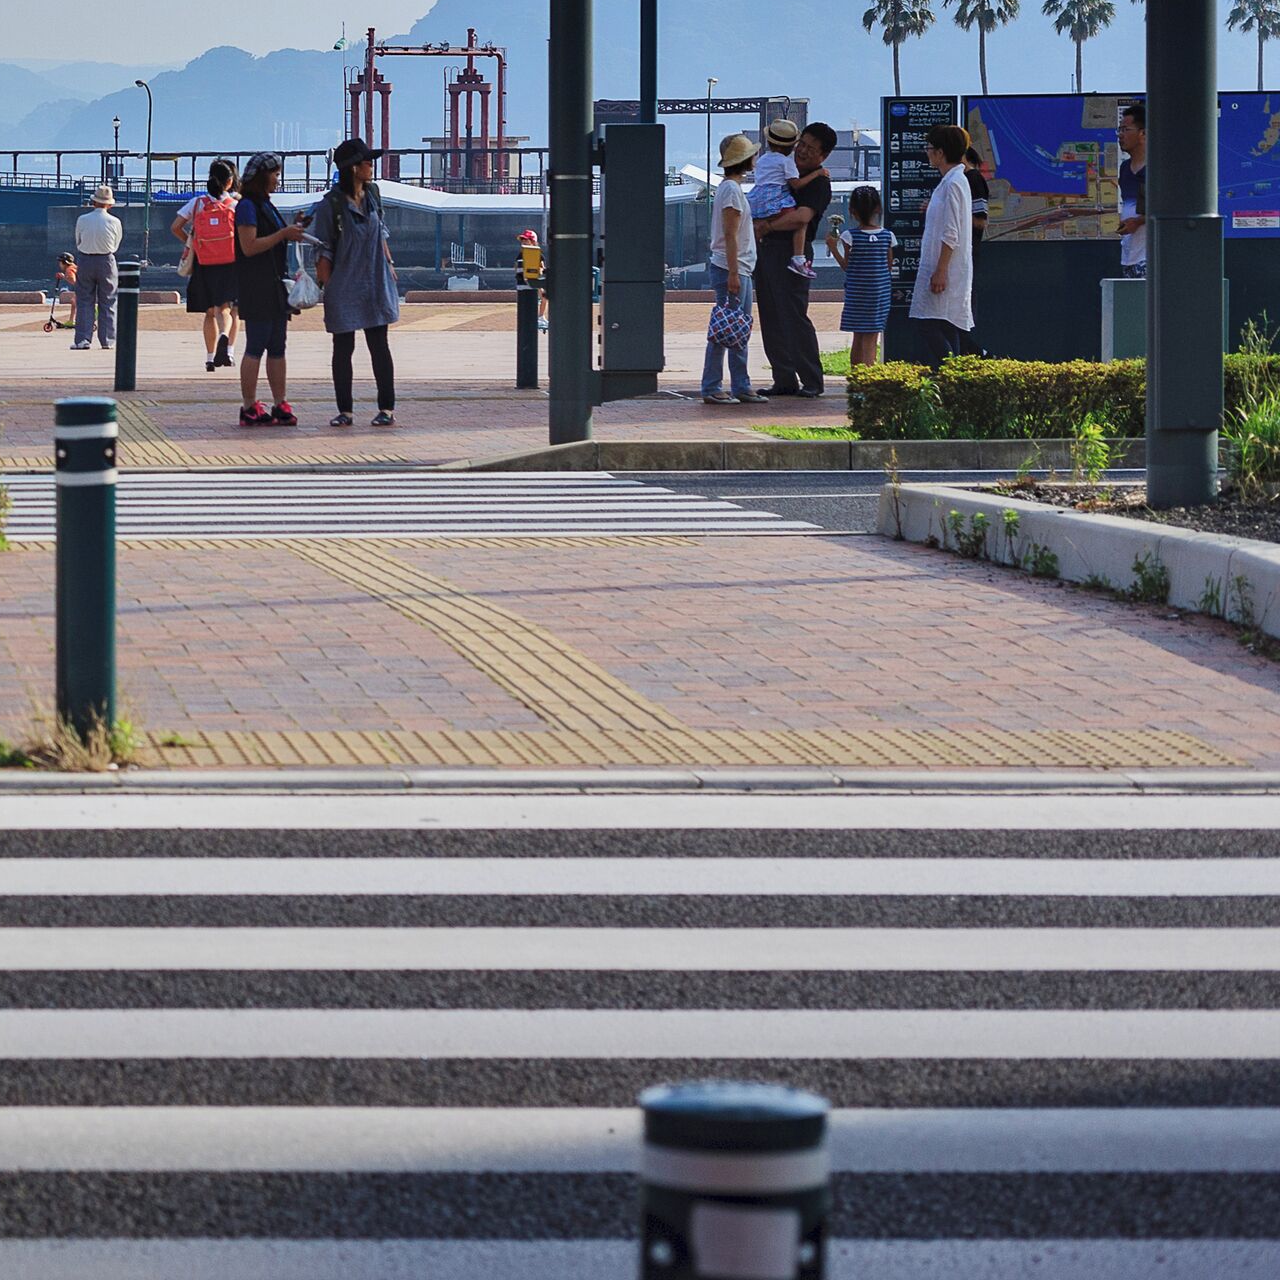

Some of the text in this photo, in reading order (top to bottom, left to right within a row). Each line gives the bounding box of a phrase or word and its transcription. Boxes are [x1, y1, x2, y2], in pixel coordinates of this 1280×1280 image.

[909, 103, 950, 112] みなとエリア
